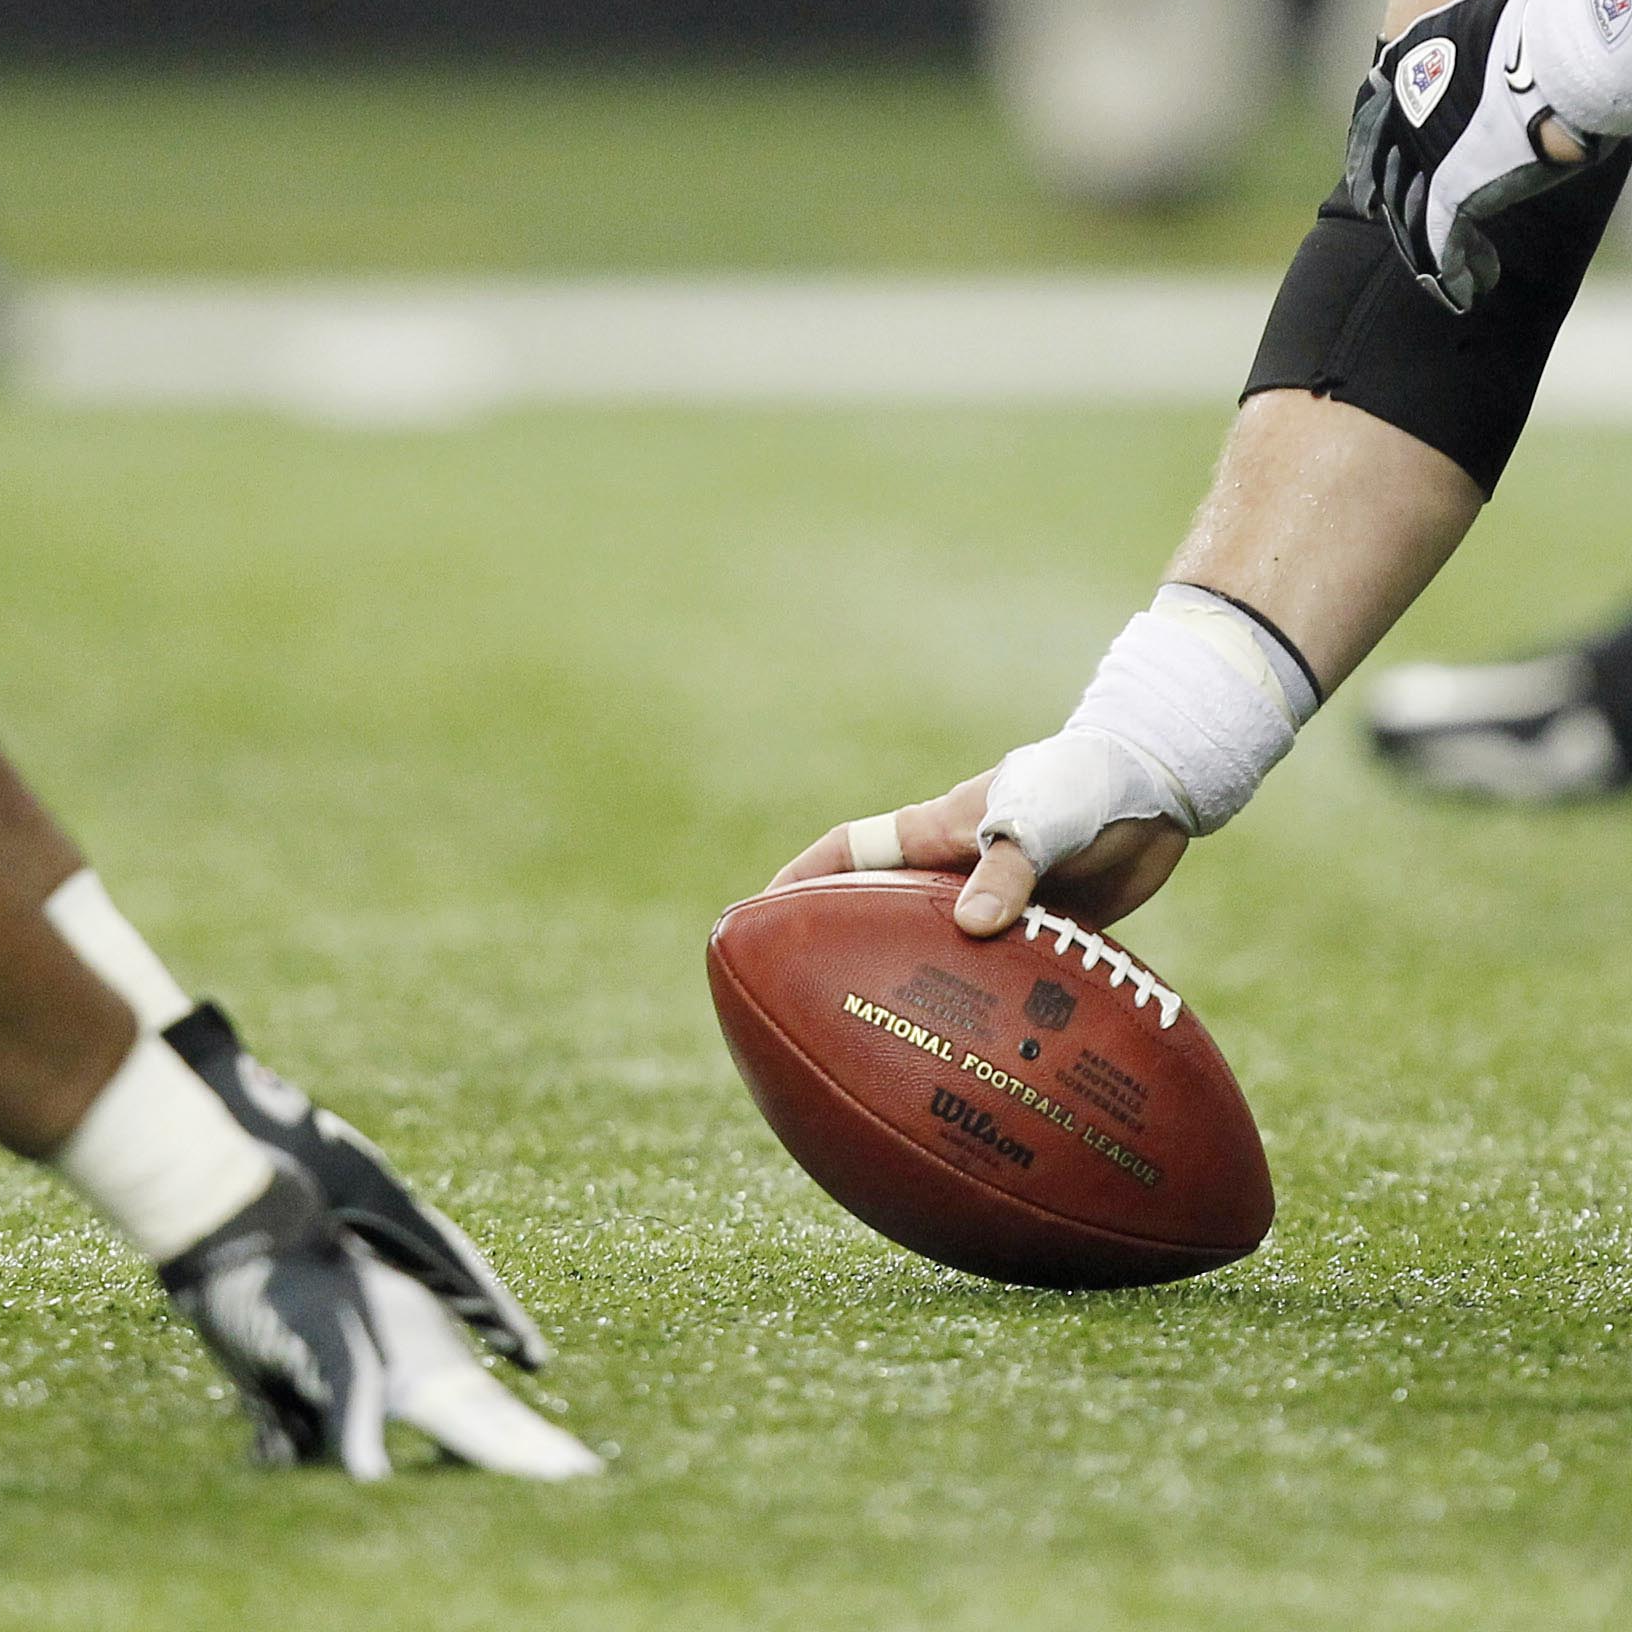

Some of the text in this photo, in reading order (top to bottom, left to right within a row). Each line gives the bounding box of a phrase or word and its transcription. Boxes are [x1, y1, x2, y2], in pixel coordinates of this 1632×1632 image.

[843, 993, 953, 1062] NATIONAL
[960, 1053, 1074, 1132] FOOTBALL
[1082, 1126, 1161, 1186] LEAGUE
[930, 1087, 1035, 1167] Wilson
[1073, 1059, 1145, 1115] FOOTBALL
